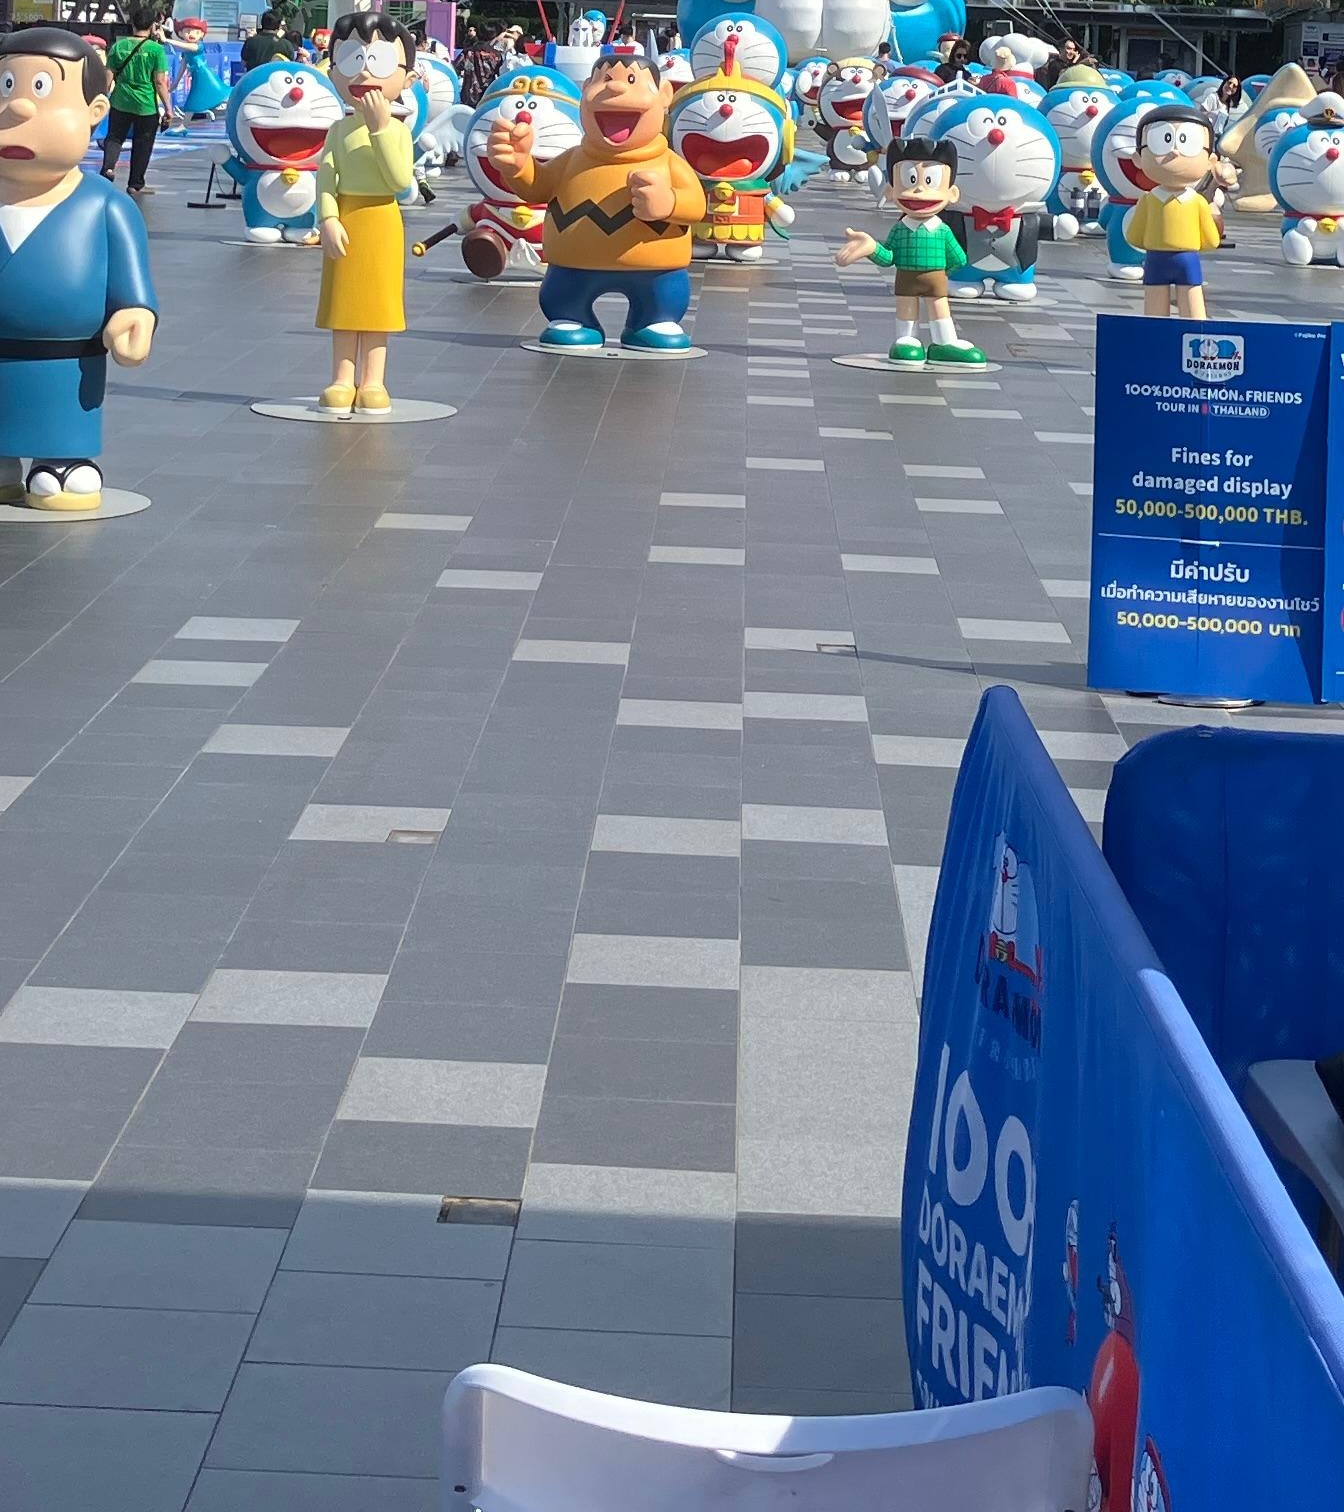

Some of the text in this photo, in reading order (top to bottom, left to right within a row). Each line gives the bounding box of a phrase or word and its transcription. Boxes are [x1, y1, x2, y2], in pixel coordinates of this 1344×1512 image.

[1186, 358, 1240, 370] DORAEMON
[1155, 401, 1268, 417] TOUR IN THAILAND
[1171, 447, 1254, 467] Fines for
[1132, 471, 1293, 500] damaged display
[1115, 498, 1308, 526] 50,000-500,000 THB.
[1170, 559, 1250, 583] มีค่าปรับ
[1268, 623, 1301, 638] บาท
